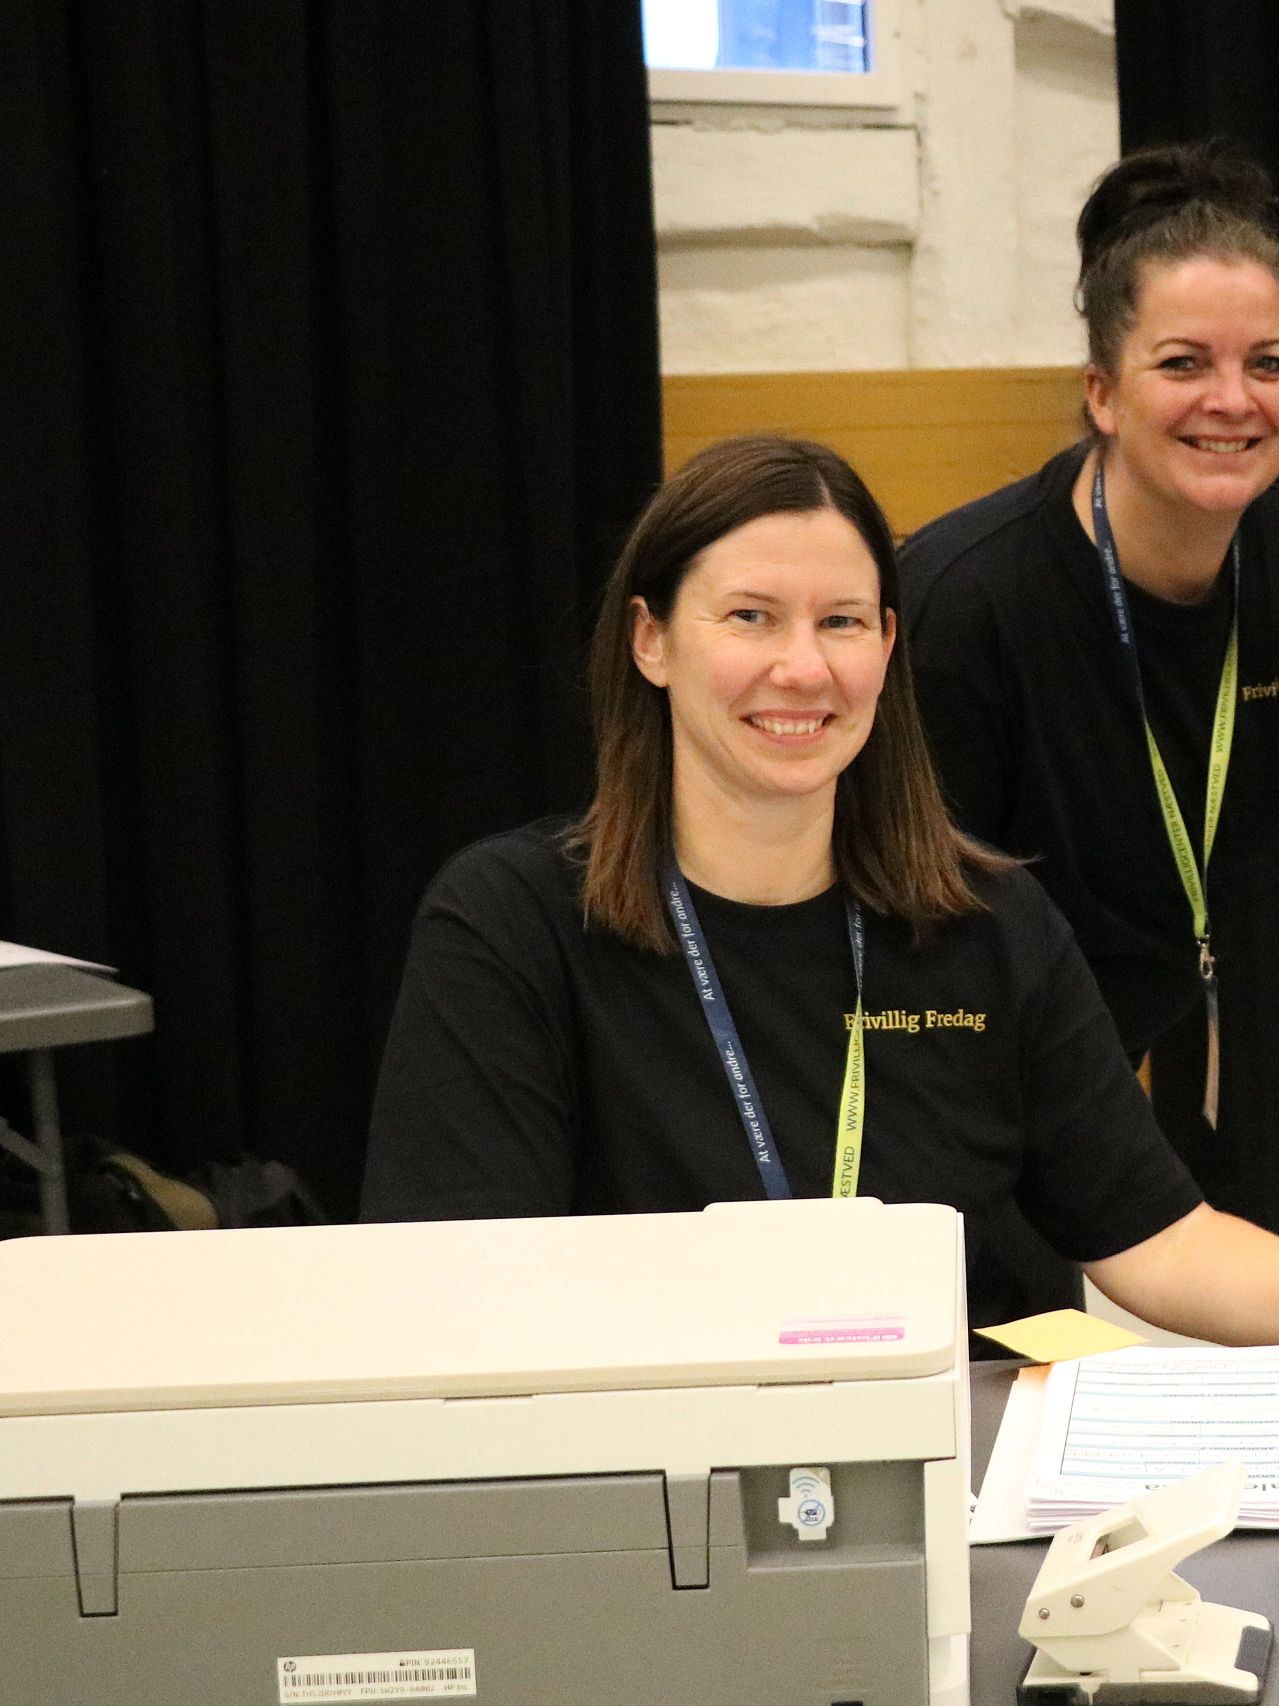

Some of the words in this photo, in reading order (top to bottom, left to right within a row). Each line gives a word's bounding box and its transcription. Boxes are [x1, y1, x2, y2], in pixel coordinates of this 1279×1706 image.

[680, 922, 695, 938] for
[687, 940, 700, 957] der
[694, 959, 709, 986] være
[702, 988, 715, 1000] At
[925, 1009, 986, 1031] Fredag
[737, 1083, 750, 1099] for
[743, 1101, 756, 1119] der
[750, 1121, 765, 1147] være
[758, 1150, 771, 1162] At
[839, 1145, 854, 1198] ÆSTVED
